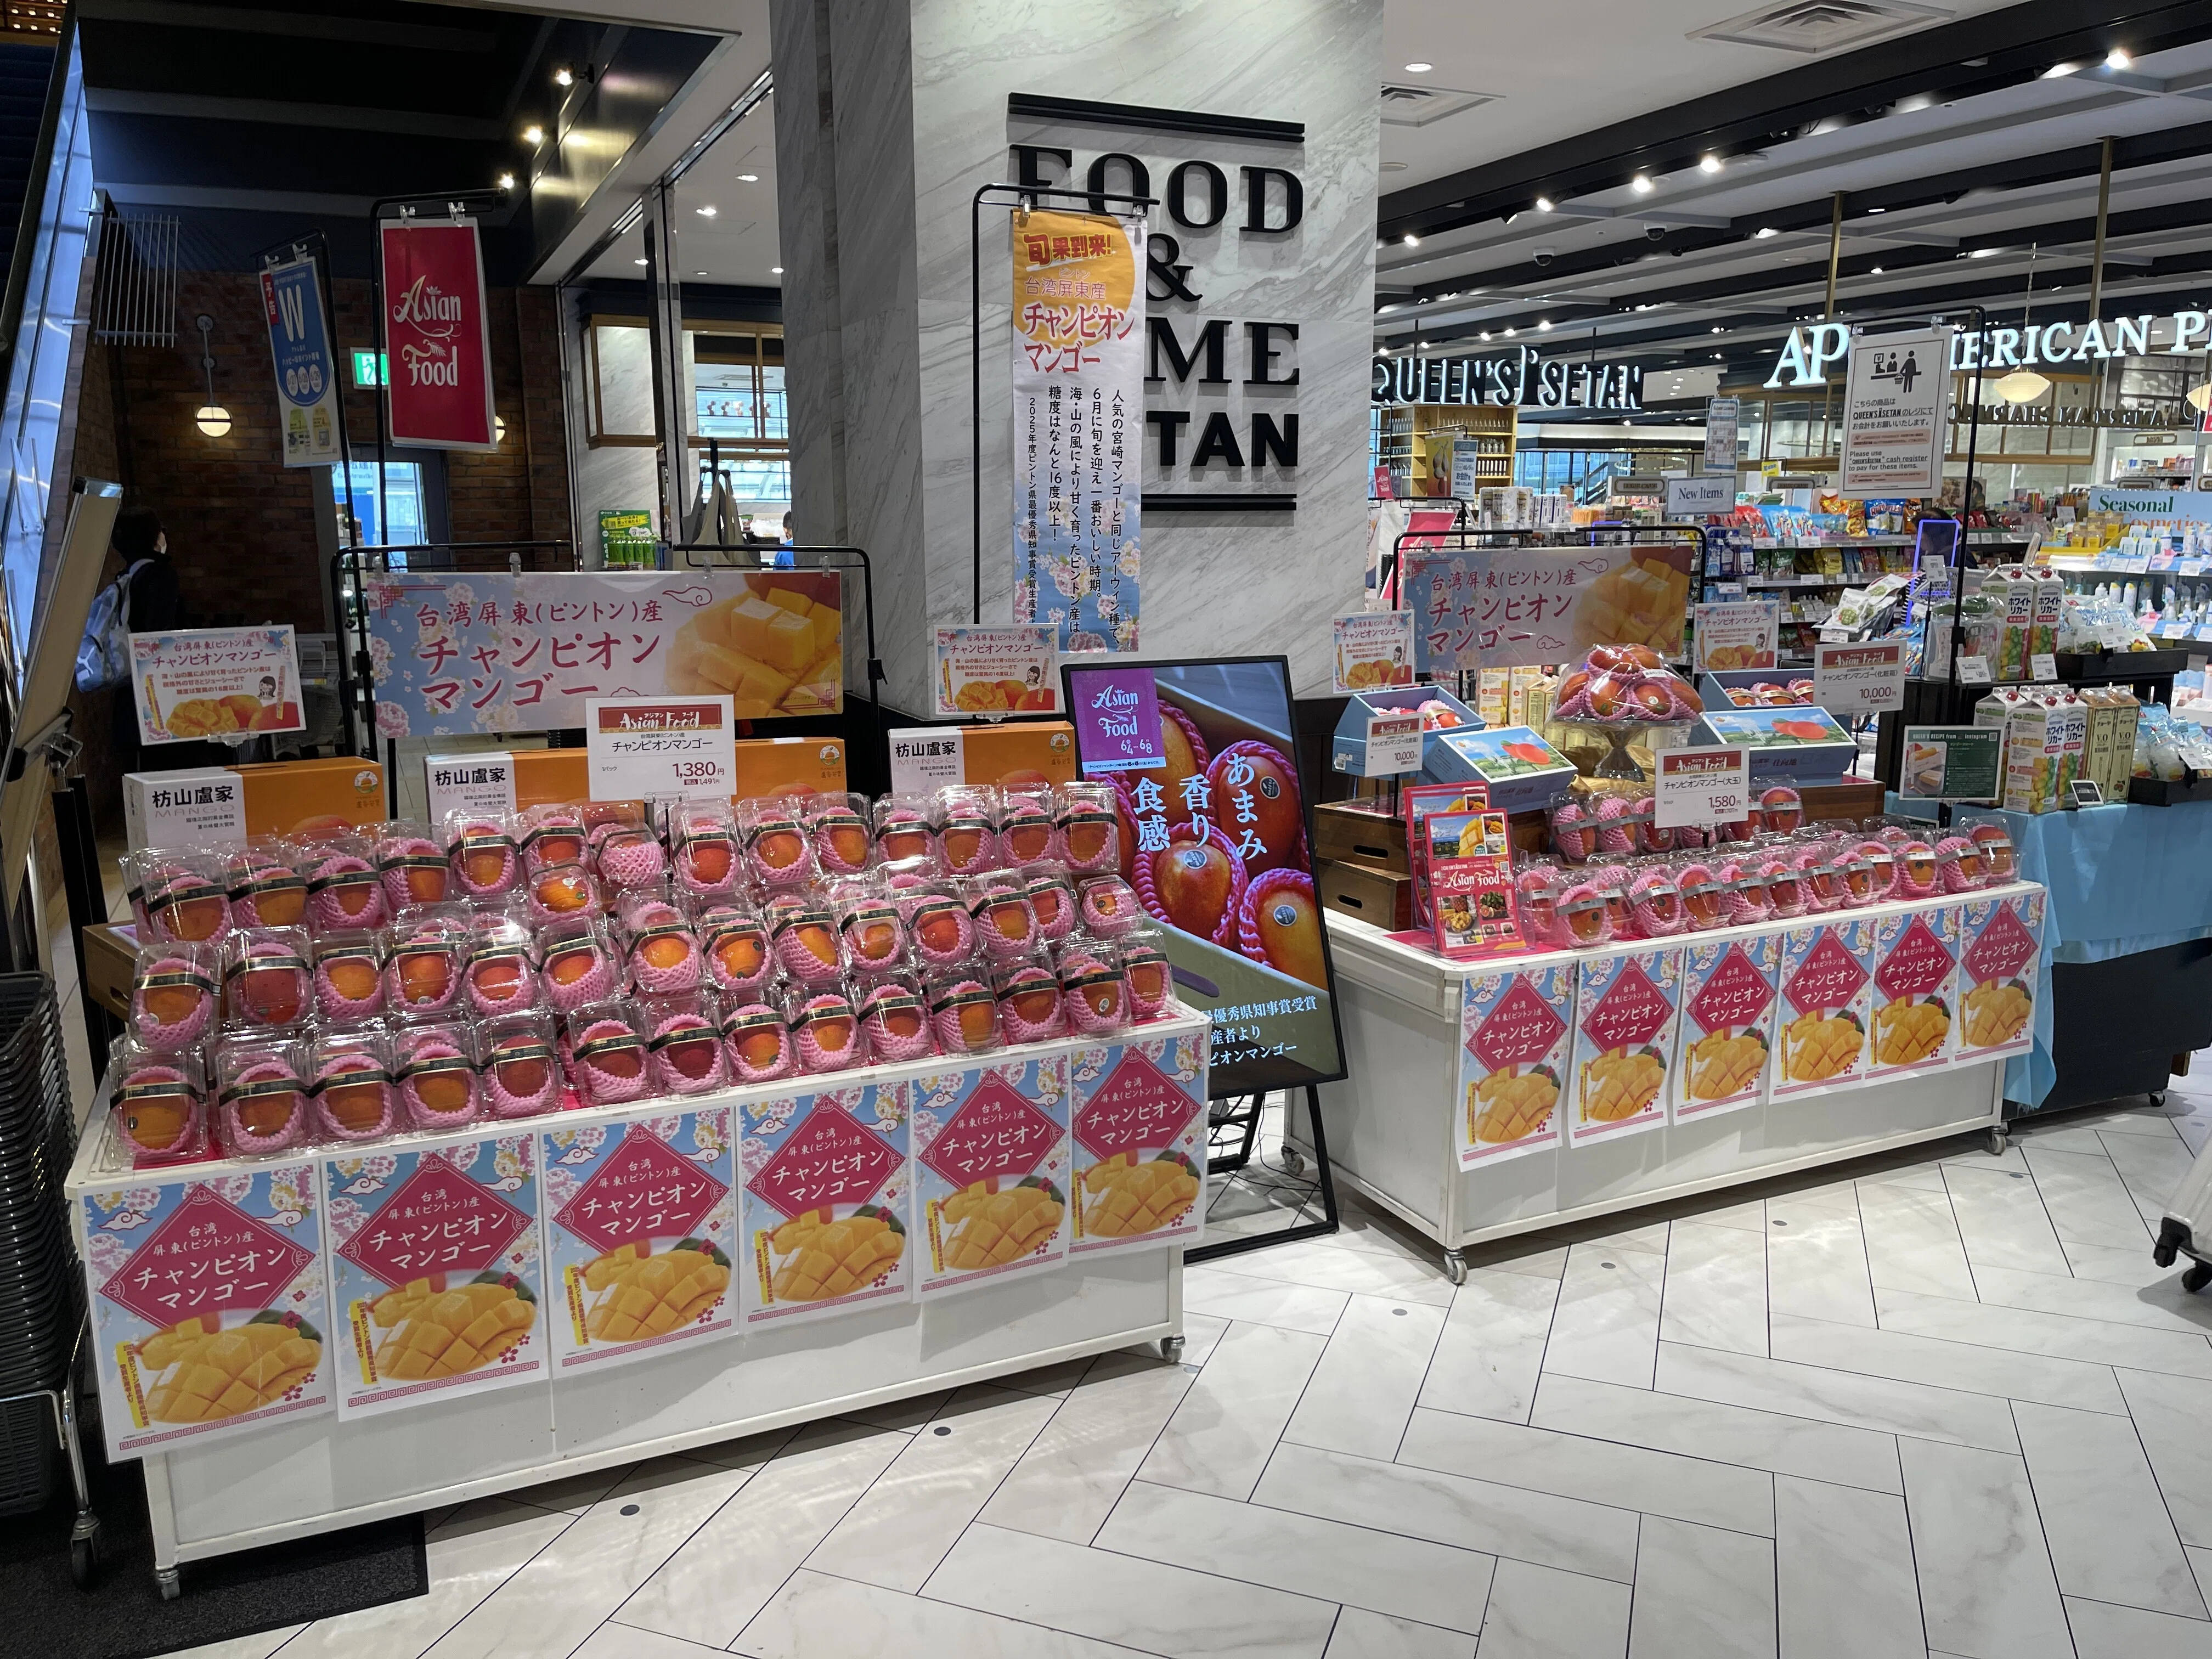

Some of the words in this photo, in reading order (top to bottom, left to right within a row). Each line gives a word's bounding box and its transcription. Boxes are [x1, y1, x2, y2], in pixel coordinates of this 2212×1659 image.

[1010, 144, 1303, 233] FOOD
[1025, 277, 1105, 300] 台湾屏東産
[278, 284, 304, 342] W
[393, 275, 462, 334] Asian
[1024, 303, 1135, 340] チャンピオン
[1144, 317, 1300, 386] ME
[1951, 314, 2153, 370] ERICAN
[402, 340, 458, 386] Food
[1024, 341, 1101, 373] マンゴー
[1854, 398, 1895, 408] こちらの商品は
[1147, 410, 1299, 467] TAN
[1090, 388, 1103, 598] 6月に旬を迎え一番おいしい時期。
[1678, 488, 1697, 500] New
[1700, 487, 1723, 499] Items
[2098, 495, 2174, 513] Seasonal
[1430, 569, 1577, 592] 台湾屏東(ピントン)産
[1427, 594, 1573, 627] チャンピオン
[2008, 597, 2031, 606] ホワイト
[2011, 606, 2028, 614] リカー
[2038, 596, 2061, 605] ホワイト
[2041, 606, 2057, 614] リカー
[416, 600, 663, 629] 台湾屏東(ピントン)産
[1705, 616, 1768, 627] チャンピオンマンゴー
[1342, 627, 1404, 640] チャンピオンマンゴー
[1428, 625, 1531, 653] マンゴー
[152, 649, 276, 669] チャンピオンマンゴー
[420, 631, 660, 676] チャンピオン
[950, 643, 1043, 654] チャンピオンマンゴー
[1835, 655, 1859, 666] Asian
[1863, 652, 1884, 664] Food
[421, 673, 599, 710] マンゴー
[1091, 685, 1138, 712] Asian
[619, 713, 659, 730] Asian
[666, 712, 699, 730] Food
[1098, 714, 1138, 737] Food
[2046, 725, 2064, 736] ホワイト
[2065, 723, 2085, 733] ホワイト
[612, 738, 713, 752] チャンピオンマンゴー
[2047, 735, 2062, 744] リカー
[2067, 732, 2083, 741] リカー
[898, 757, 956, 765] MANGO
[1677, 760, 1701, 772] Asian
[1705, 757, 1727, 770] Food
[437, 785, 506, 795] MANGO
[1664, 776, 1741, 789] チャンピオンマンゴー(大玉)
[155, 804, 235, 819] MANGO
[1131, 777, 1170, 851] 食感
[1179, 774, 1211, 848] 香り
[1227, 753, 1267, 860] あまみ
[1443, 870, 1475, 889] Asian
[1474, 869, 1499, 887] Food
[1973, 940, 2029, 961] チャンピオン
[1884, 956, 1946, 977] チャンピオン
[1979, 958, 2019, 973] マンゴー
[1795, 969, 1859, 991] チャンピオン
[1891, 975, 1936, 990] マンゴー
[1700, 985, 1765, 1008] チャンピオン
[1802, 989, 1848, 1005] マンゴー
[1596, 1002, 1664, 1026] チャンピオン
[1707, 1006, 1755, 1023] マンゴー
[1482, 1020, 1555, 1046] チャンピオン
[1604, 1024, 1652, 1041] マンゴー
[1492, 1042, 1544, 1060] マンゴー
[1124, 1077, 1142, 1089] 台湾
[981, 1102, 1001, 1114] 台湾
[1087, 1099, 1184, 1131] チャンピオン
[815, 1127, 836, 1141] 台湾
[943, 1123, 1047, 1157] チャンピオン
[1100, 1124, 1171, 1145] マンゴー
[627, 1159, 651, 1172] 台湾
[771, 1149, 884, 1186] チャンピオン
[957, 1149, 1033, 1173] マンゴー
[421, 1189, 448, 1202] 台湾
[582, 1181, 707, 1218] チャンピオン
[788, 1177, 870, 1202] マンゴー
[188, 1223, 217, 1237] 台湾
[369, 1212, 508, 1252] チャンピオン
[599, 1211, 691, 1237] マンゴー
[390, 1242, 492, 1271] マンゴー
[133, 1246, 287, 1291] チャンピオン
[157, 1282, 269, 1310] マンゴー
